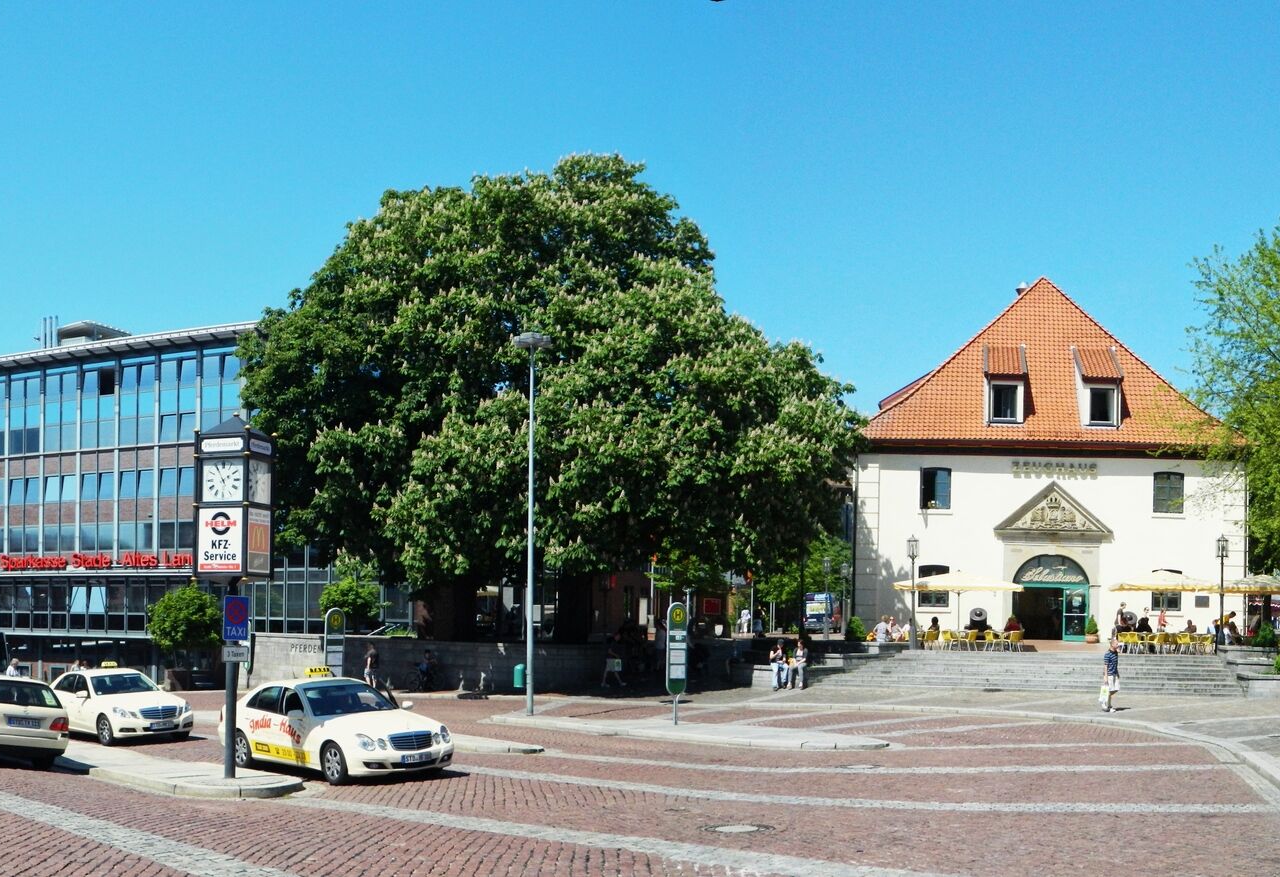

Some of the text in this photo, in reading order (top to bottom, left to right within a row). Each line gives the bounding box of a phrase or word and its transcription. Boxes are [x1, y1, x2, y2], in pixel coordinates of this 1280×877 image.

[1011, 461, 1098, 476] ZEUGHAUS
[205, 520, 237, 528] HELM
[211, 539, 231, 550] KFZ-
[204, 550, 237, 561] Service
[0, 553, 66, 572] Sparkasse
[71, 551, 111, 568] Stade
[122, 551, 158, 567] Altes
[226, 626, 246, 637] TAXI
[250, 714, 272, 734] India
[279, 718, 302, 745] Haus
